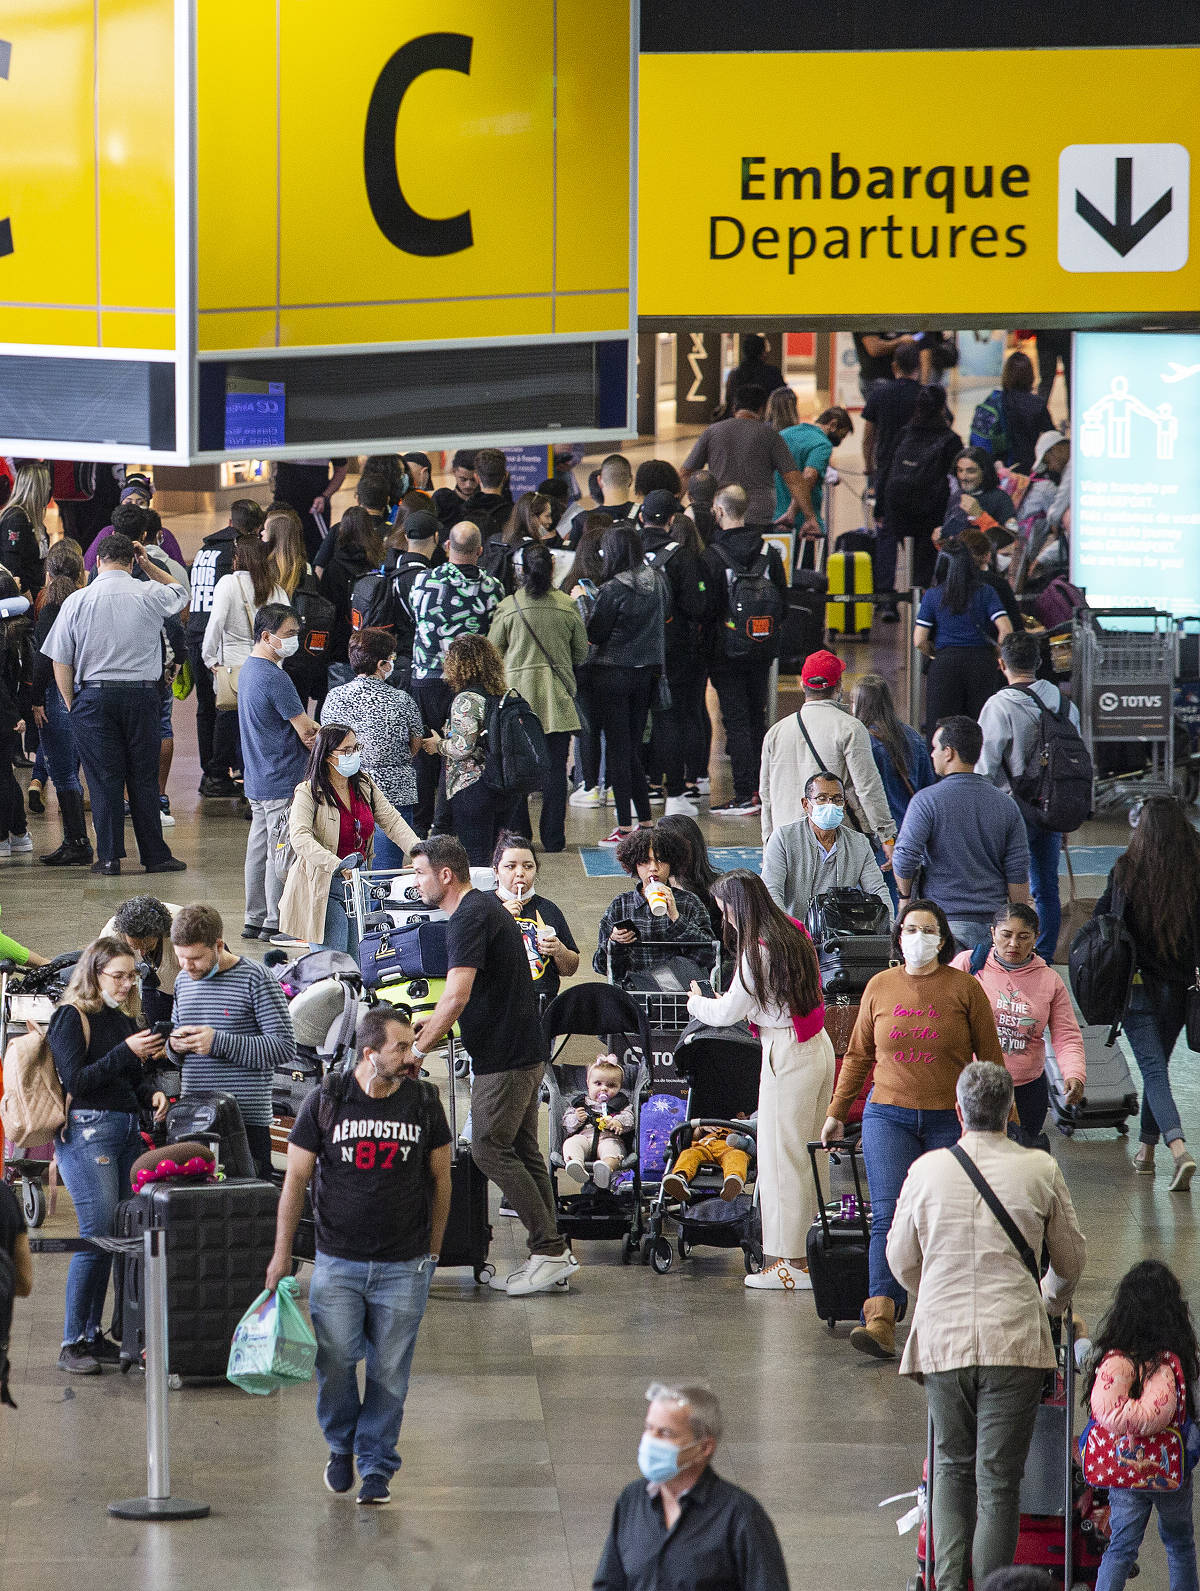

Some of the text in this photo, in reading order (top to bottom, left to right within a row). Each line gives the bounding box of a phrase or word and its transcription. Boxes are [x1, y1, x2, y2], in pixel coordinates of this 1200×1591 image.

[363, 32, 474, 258] C
[741, 152, 1031, 214] Embarque
[709, 215, 1029, 275] Departures
[190, 567, 216, 586] OUR
[190, 586, 214, 612] IFE
[1120, 695, 1162, 708] TOTVS
[892, 1004, 925, 1018] love
[996, 1000, 1028, 1014] BE THE
[998, 1014, 1022, 1027] BEST
[888, 1025, 940, 1040] in the
[1008, 1039, 1026, 1050] YOU
[892, 1048, 937, 1064] air
[340, 1140, 412, 1170] N 87 Y
